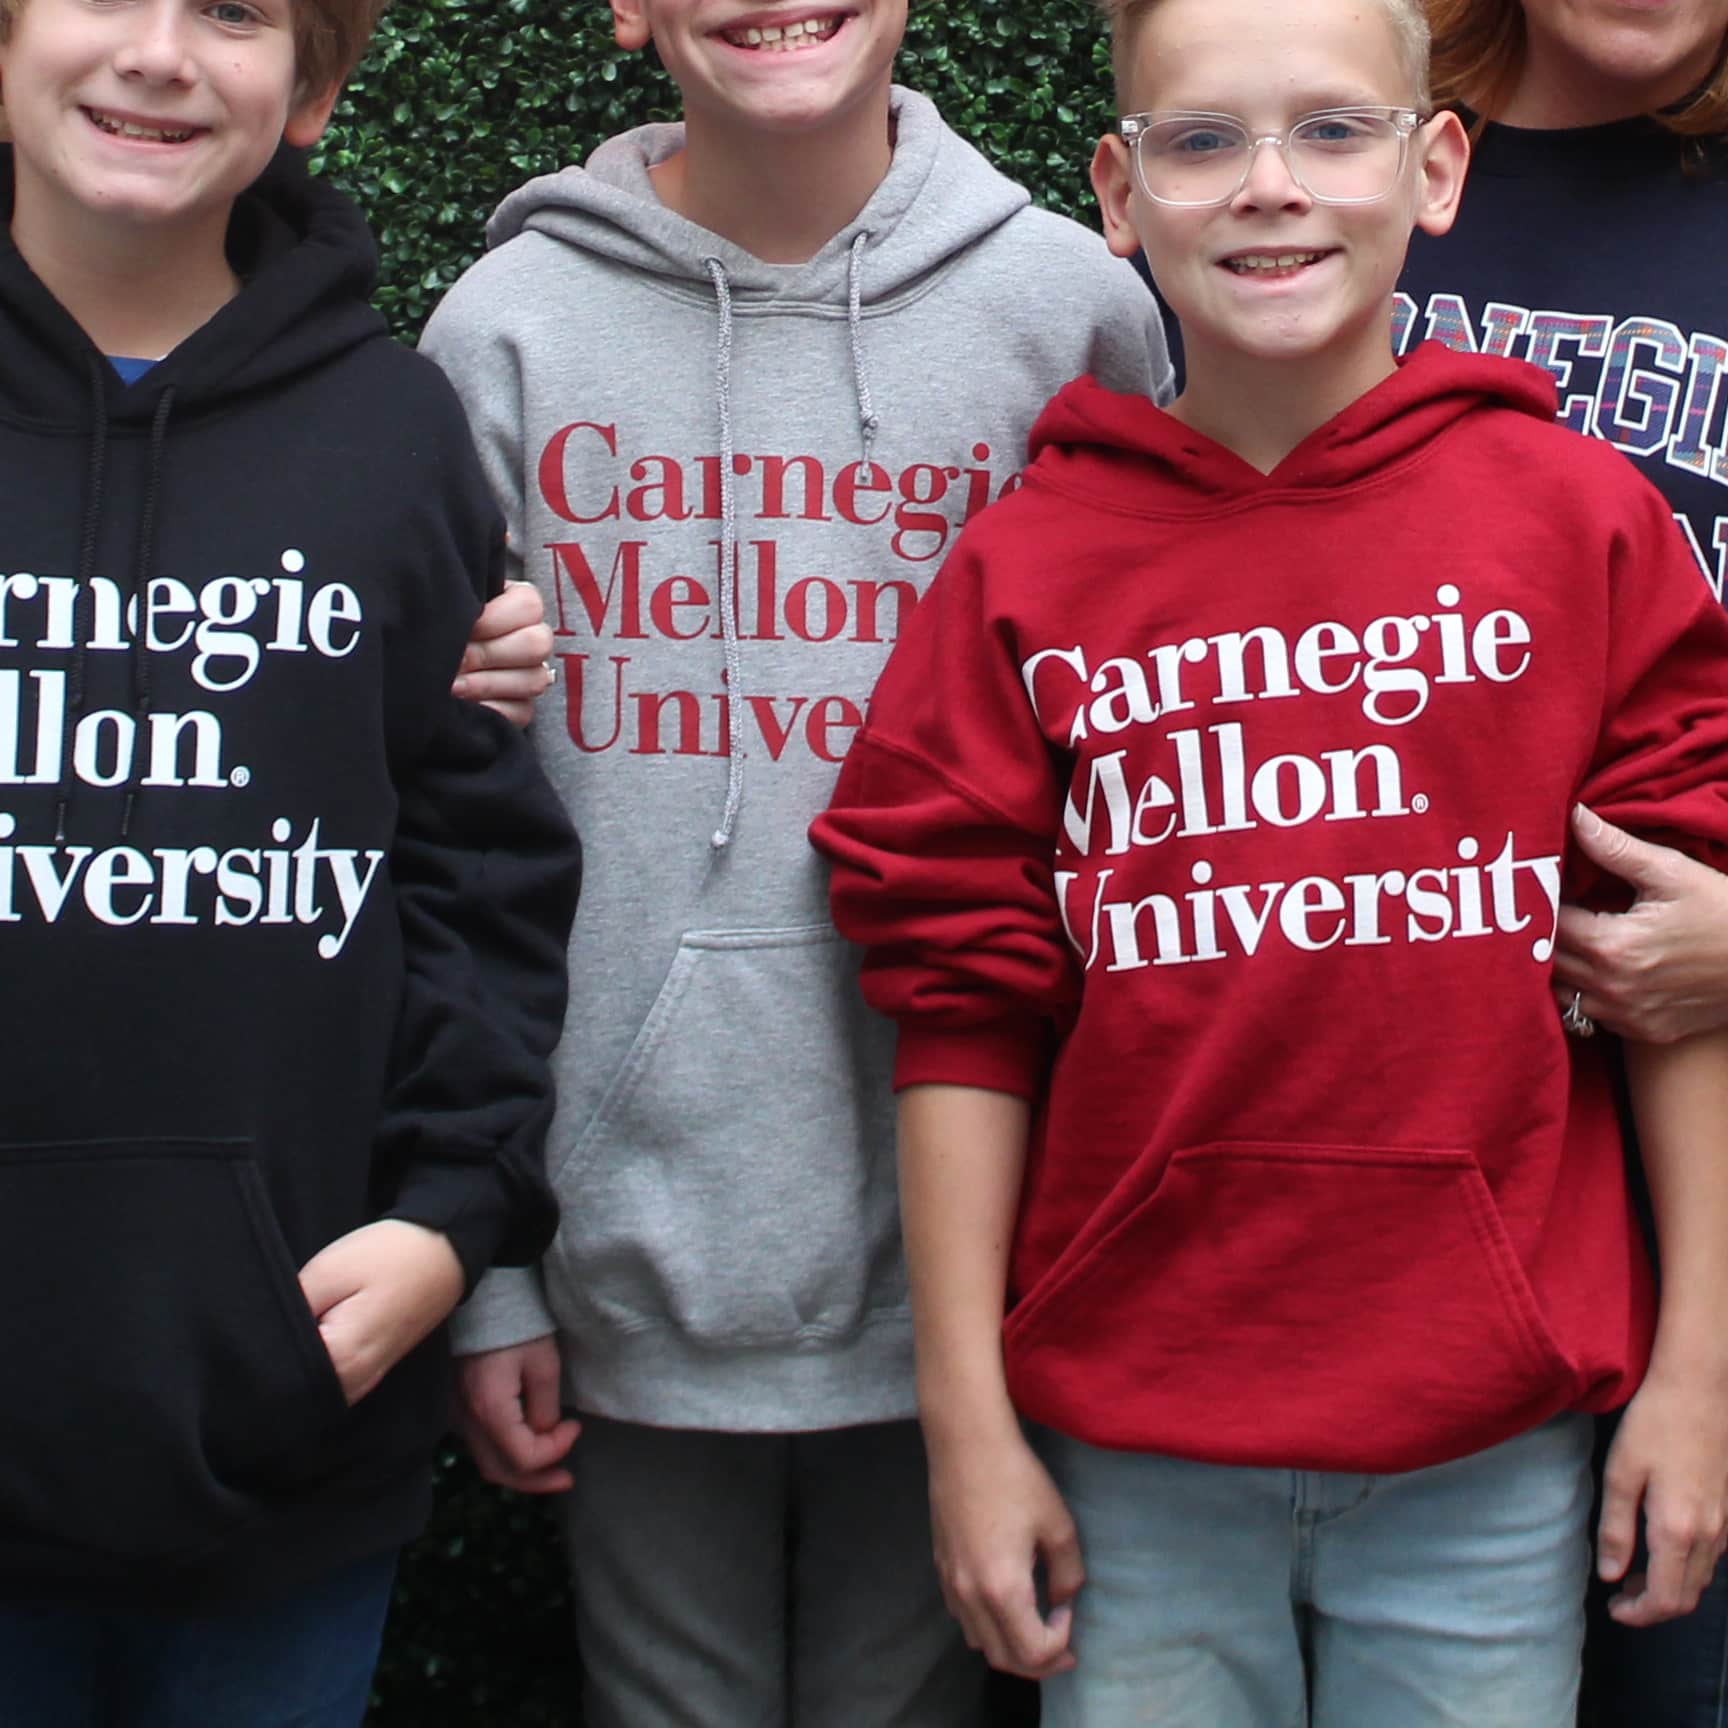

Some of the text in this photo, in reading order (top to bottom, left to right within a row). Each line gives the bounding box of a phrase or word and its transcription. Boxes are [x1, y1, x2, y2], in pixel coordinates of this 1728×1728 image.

[554, 652, 874, 763] Unive
[1022, 584, 1532, 747] Carnegie
[1054, 831, 1562, 973] University
